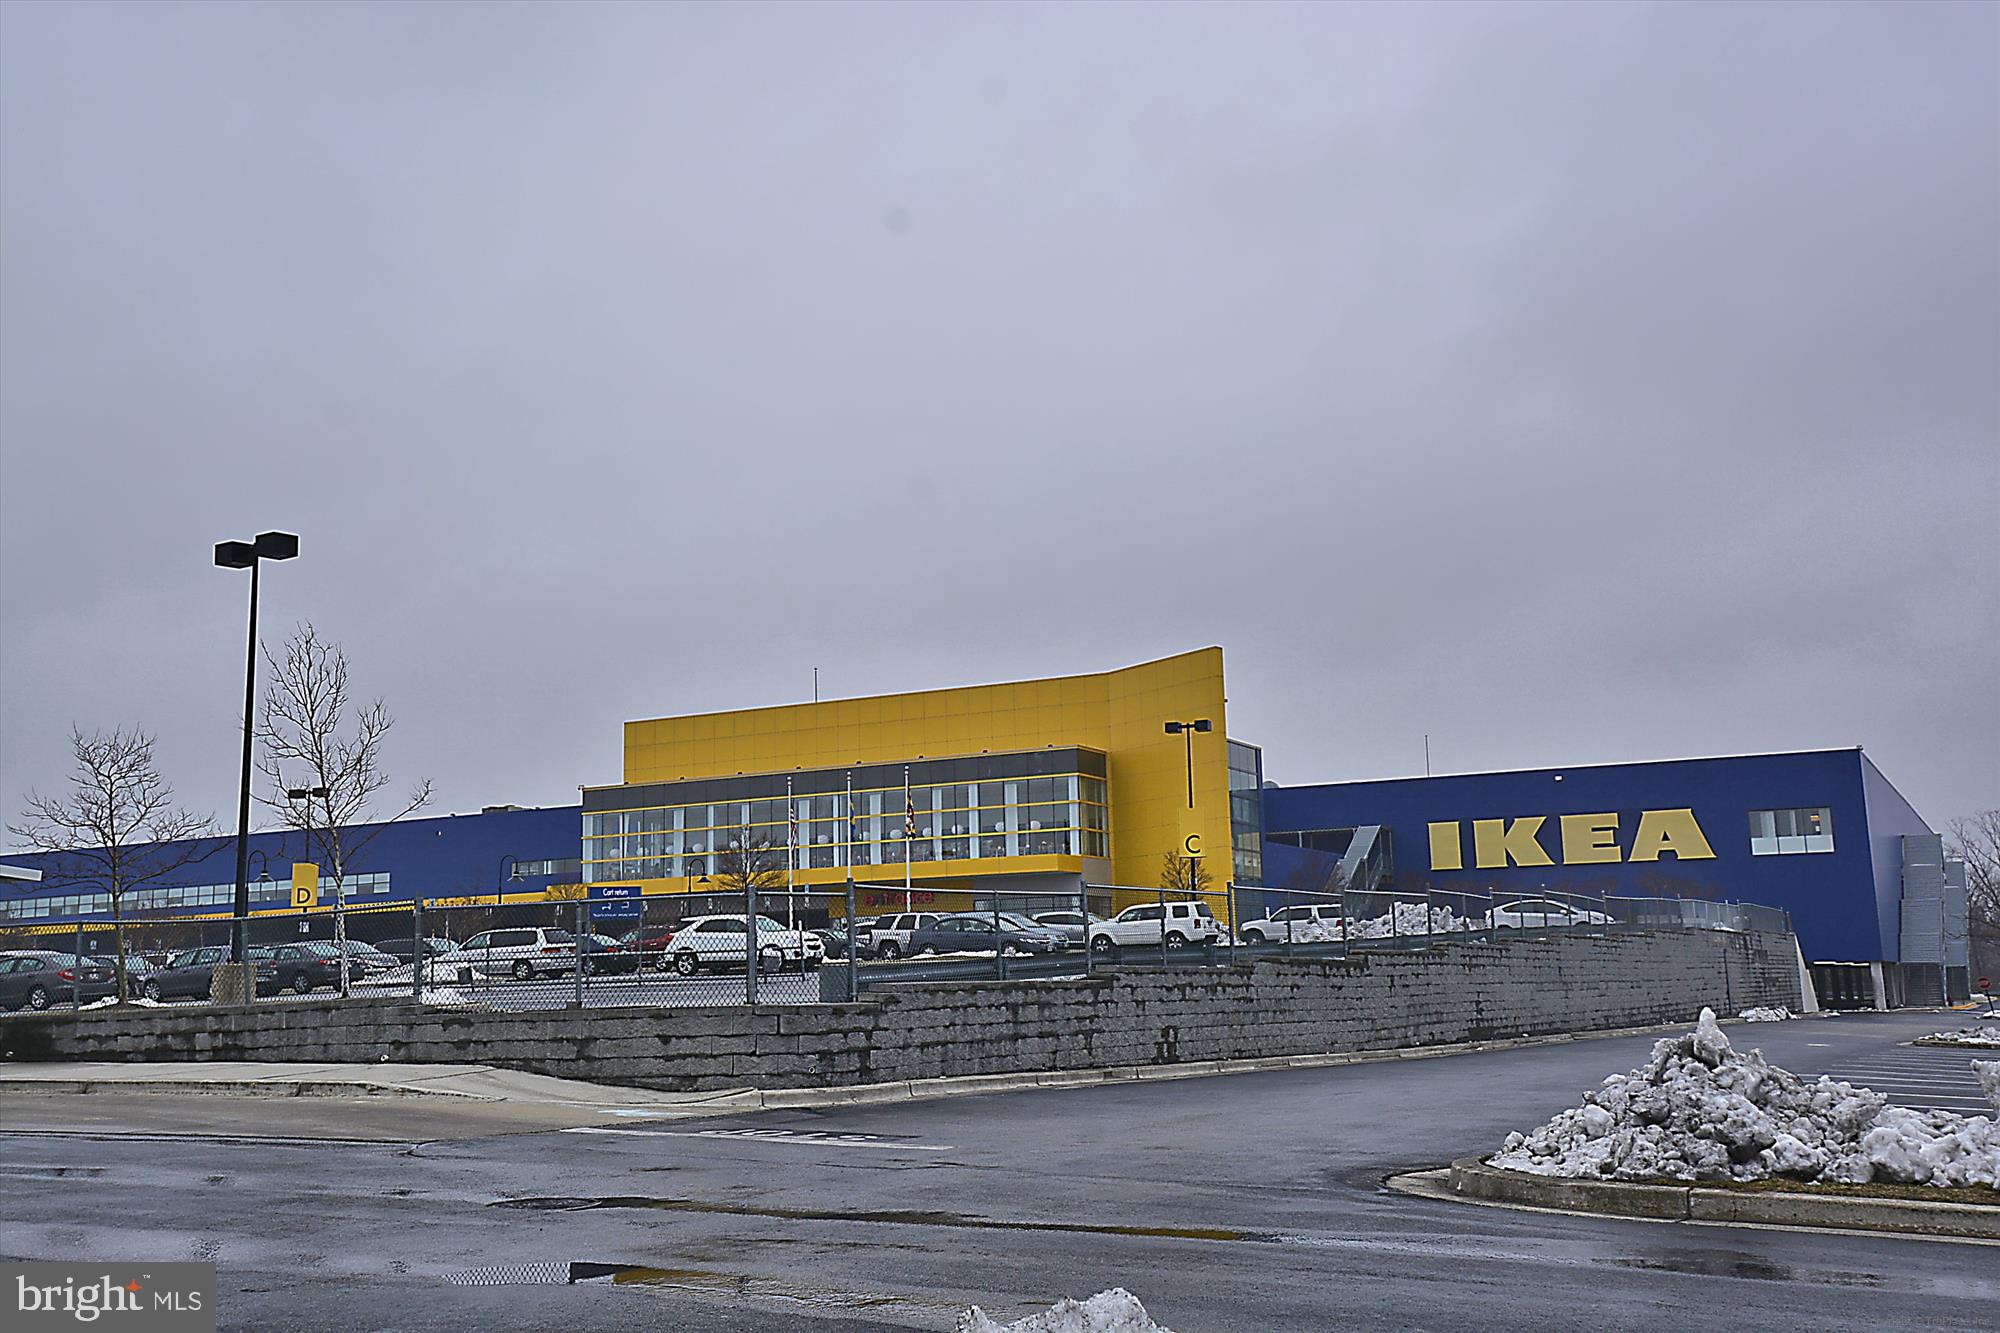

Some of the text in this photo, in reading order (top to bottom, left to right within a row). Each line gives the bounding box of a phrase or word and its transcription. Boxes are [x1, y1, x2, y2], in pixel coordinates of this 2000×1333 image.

[1185, 834, 1201, 854] C
[1427, 808, 1717, 870] IKEA
[296, 887, 311, 904] D
[602, 888, 613, 896] Cart
[864, 892, 934, 906] etace
